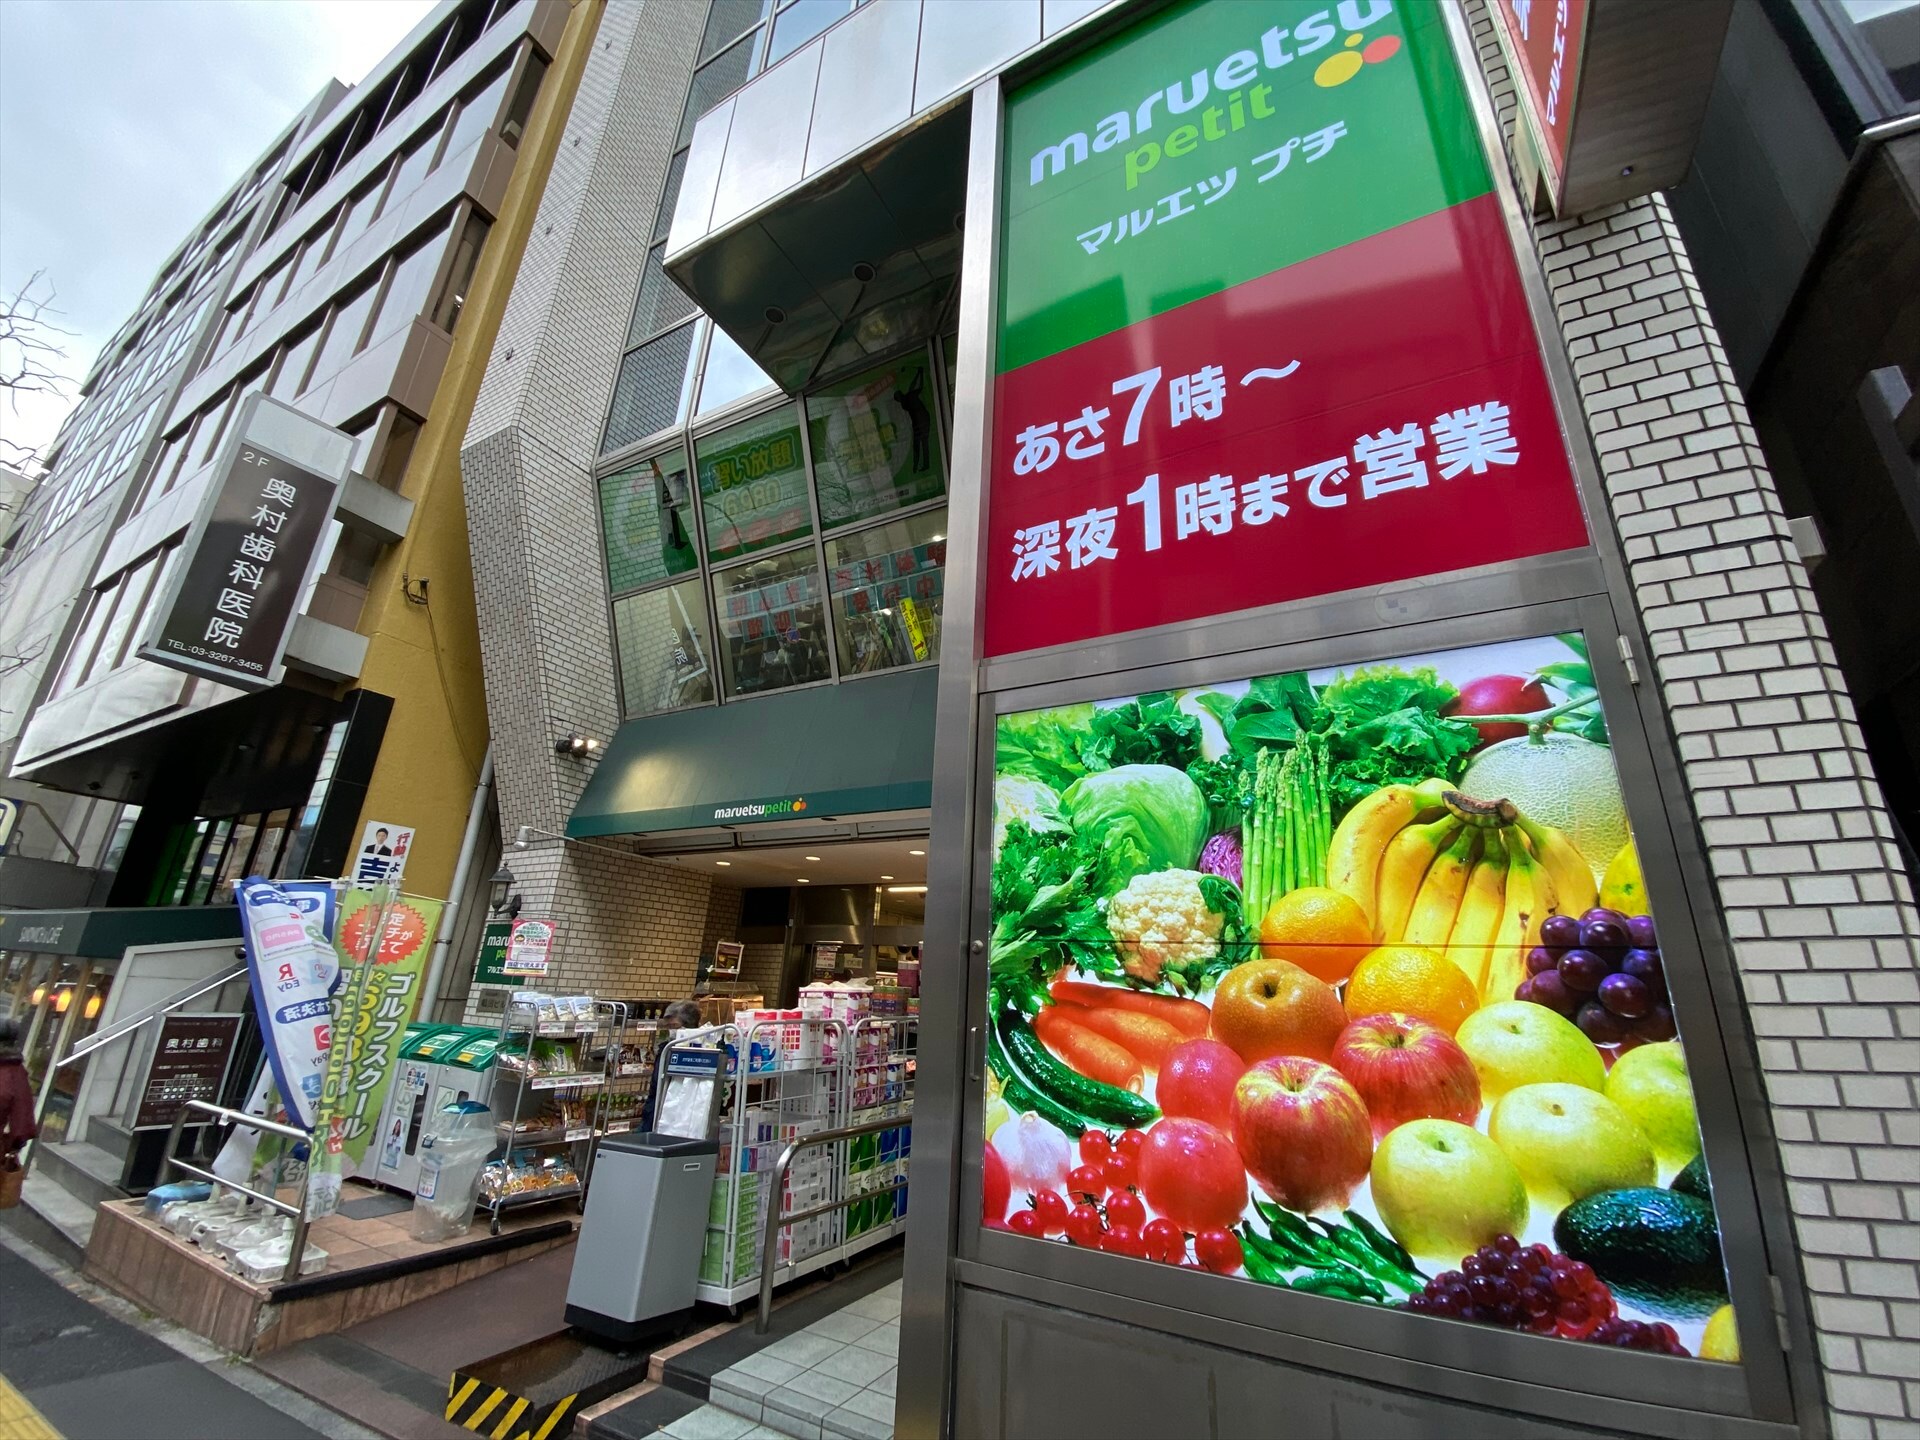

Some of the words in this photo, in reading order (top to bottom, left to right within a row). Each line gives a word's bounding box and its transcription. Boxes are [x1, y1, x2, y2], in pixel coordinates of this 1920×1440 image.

[1030, 0, 1393, 186] maruetsu
[1124, 83, 1276, 190] petit
[1076, 167, 1238, 254] マルエツ
[1252, 120, 1348, 183] プチ
[242, 451, 269, 467] 2F
[713, 439, 791, 490] 習い放題
[1010, 400, 1521, 582] 深夜1時まで営業
[204, 477, 297, 649] 奥村歯科医院
[343, 973, 415, 1139] ゴルフスクール
